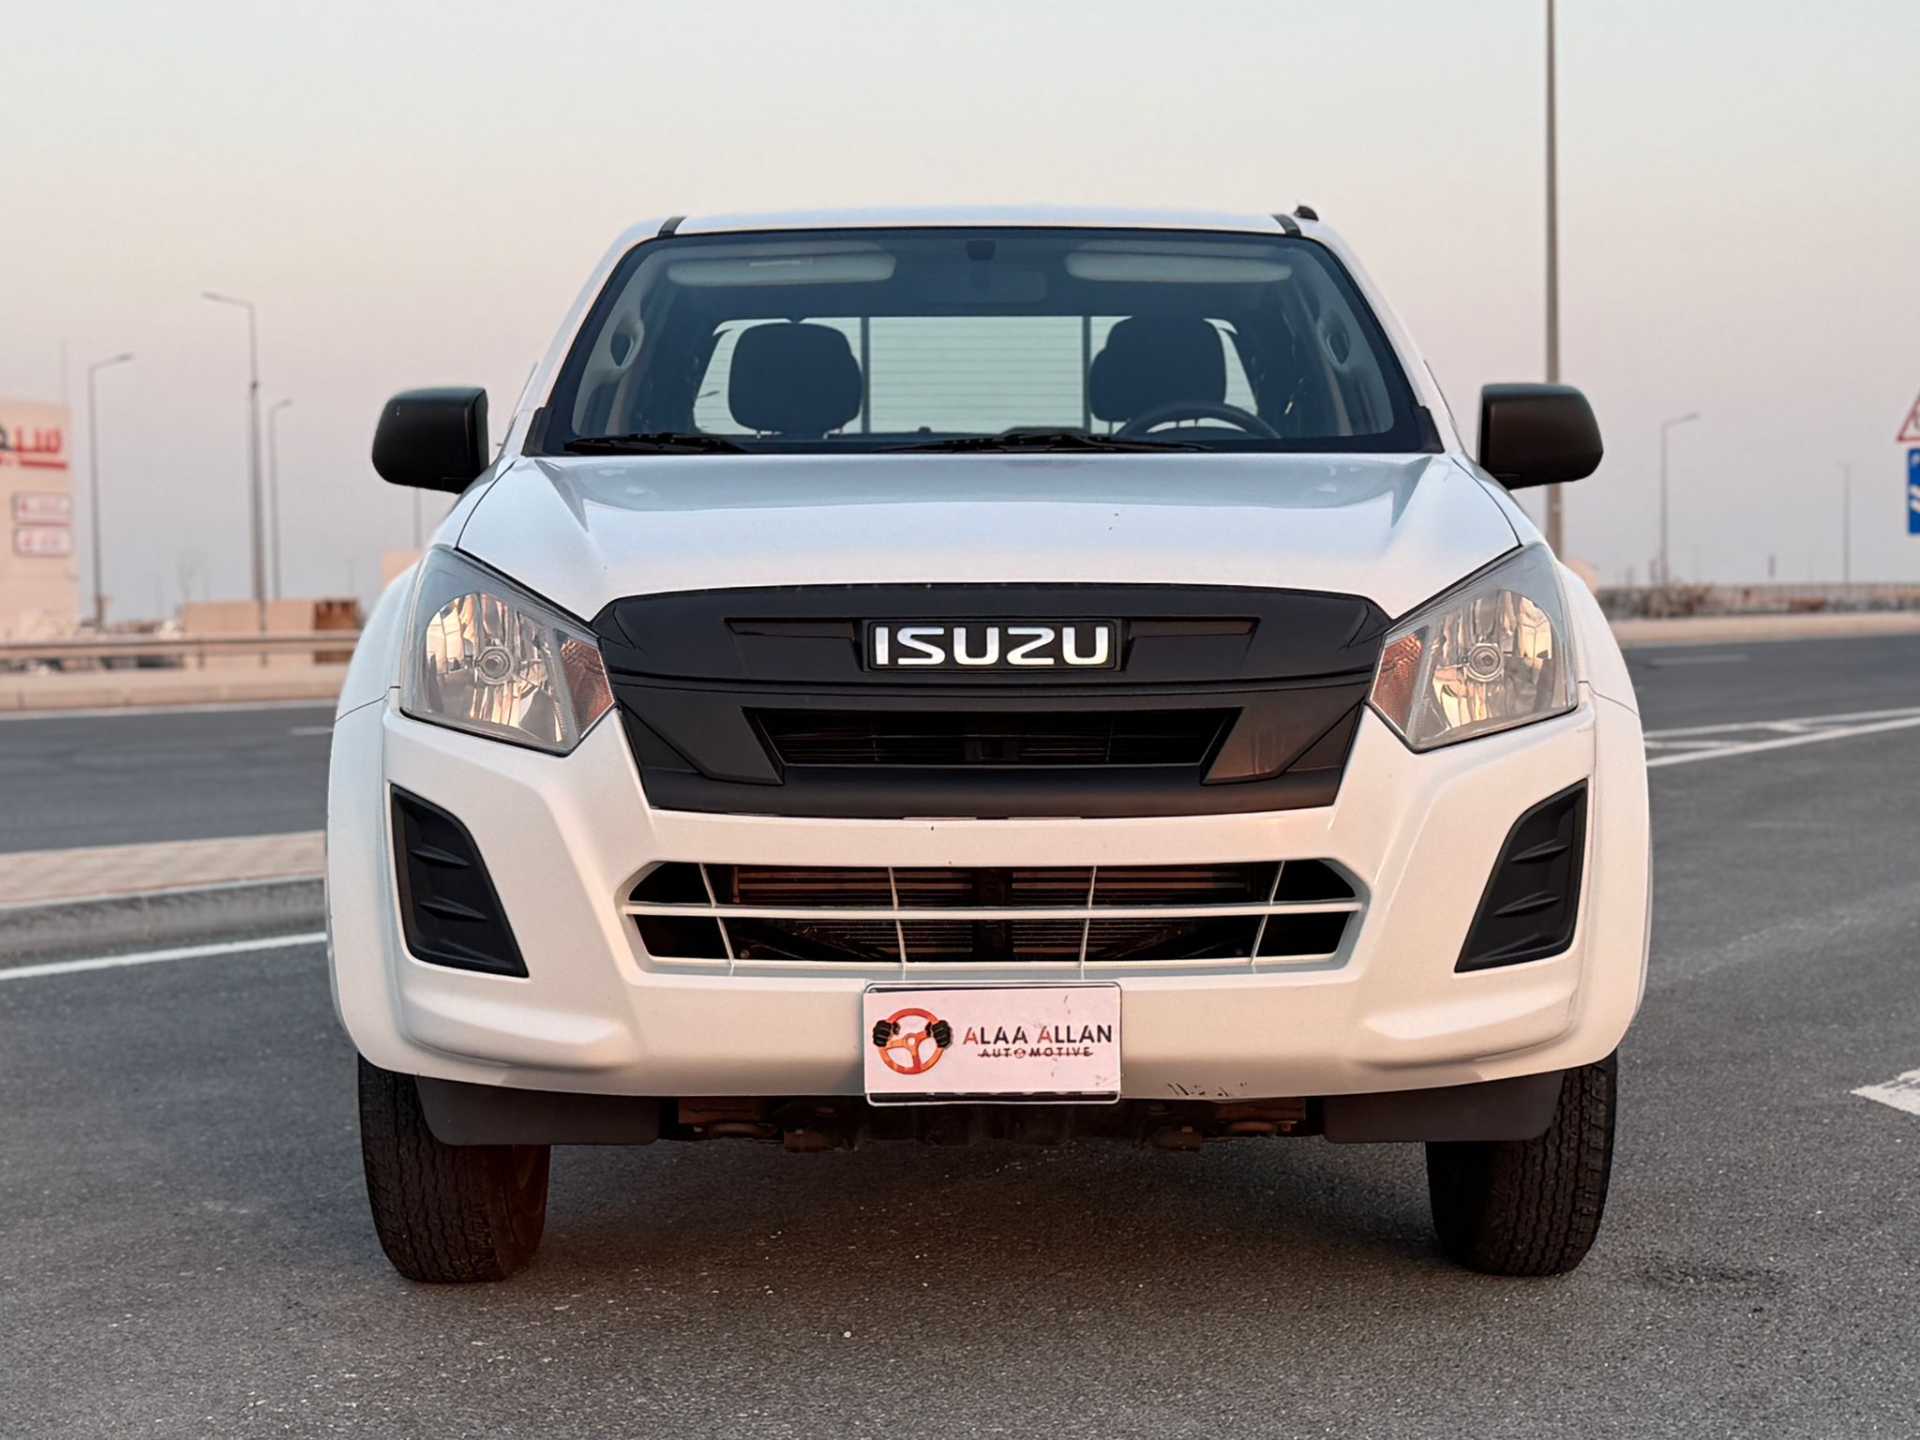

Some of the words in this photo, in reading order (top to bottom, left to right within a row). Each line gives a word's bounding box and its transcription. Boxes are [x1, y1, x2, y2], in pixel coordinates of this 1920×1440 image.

[875, 626, 1109, 665] ISUZU
[963, 1025, 1028, 1045] ALAA
[1037, 1024, 1113, 1044] ALLAN
[977, 1046, 1094, 1058] AUTOMOTIVE
